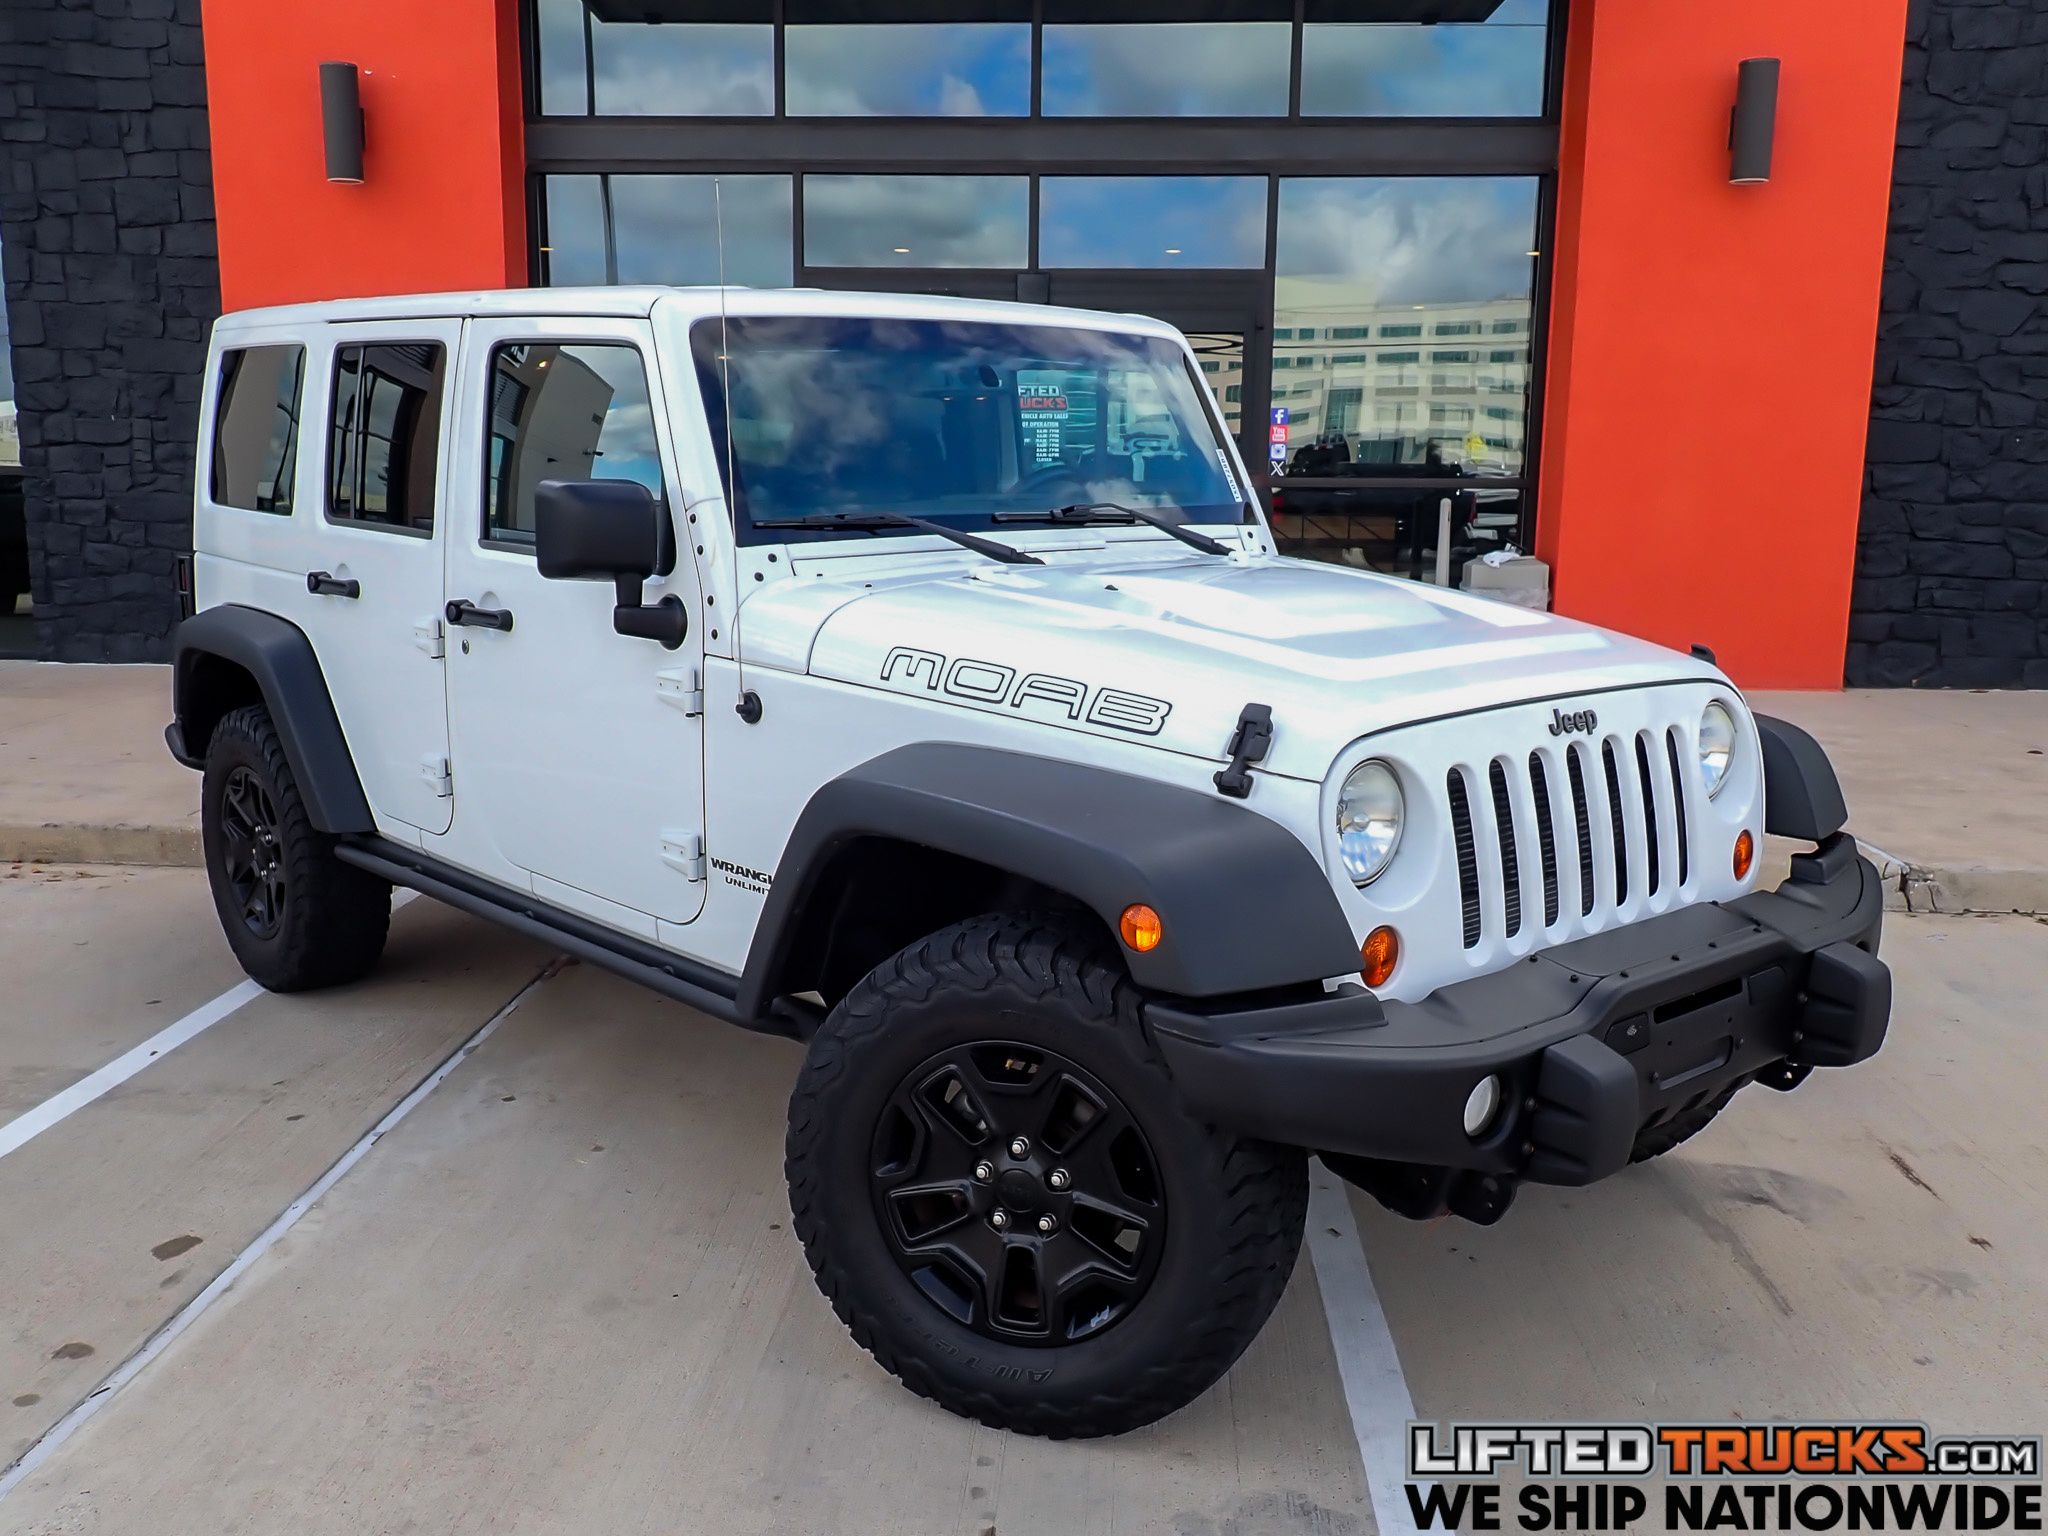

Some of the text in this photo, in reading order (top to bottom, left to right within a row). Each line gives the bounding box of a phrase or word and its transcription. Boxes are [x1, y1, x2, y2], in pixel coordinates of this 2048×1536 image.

[1018, 385, 1060, 397] FTED
[1020, 397, 1067, 410] UCKS
[880, 646, 1173, 736] MOAB
[1548, 708, 1598, 736] Jeep
[725, 876, 770, 895] UNLIMI
